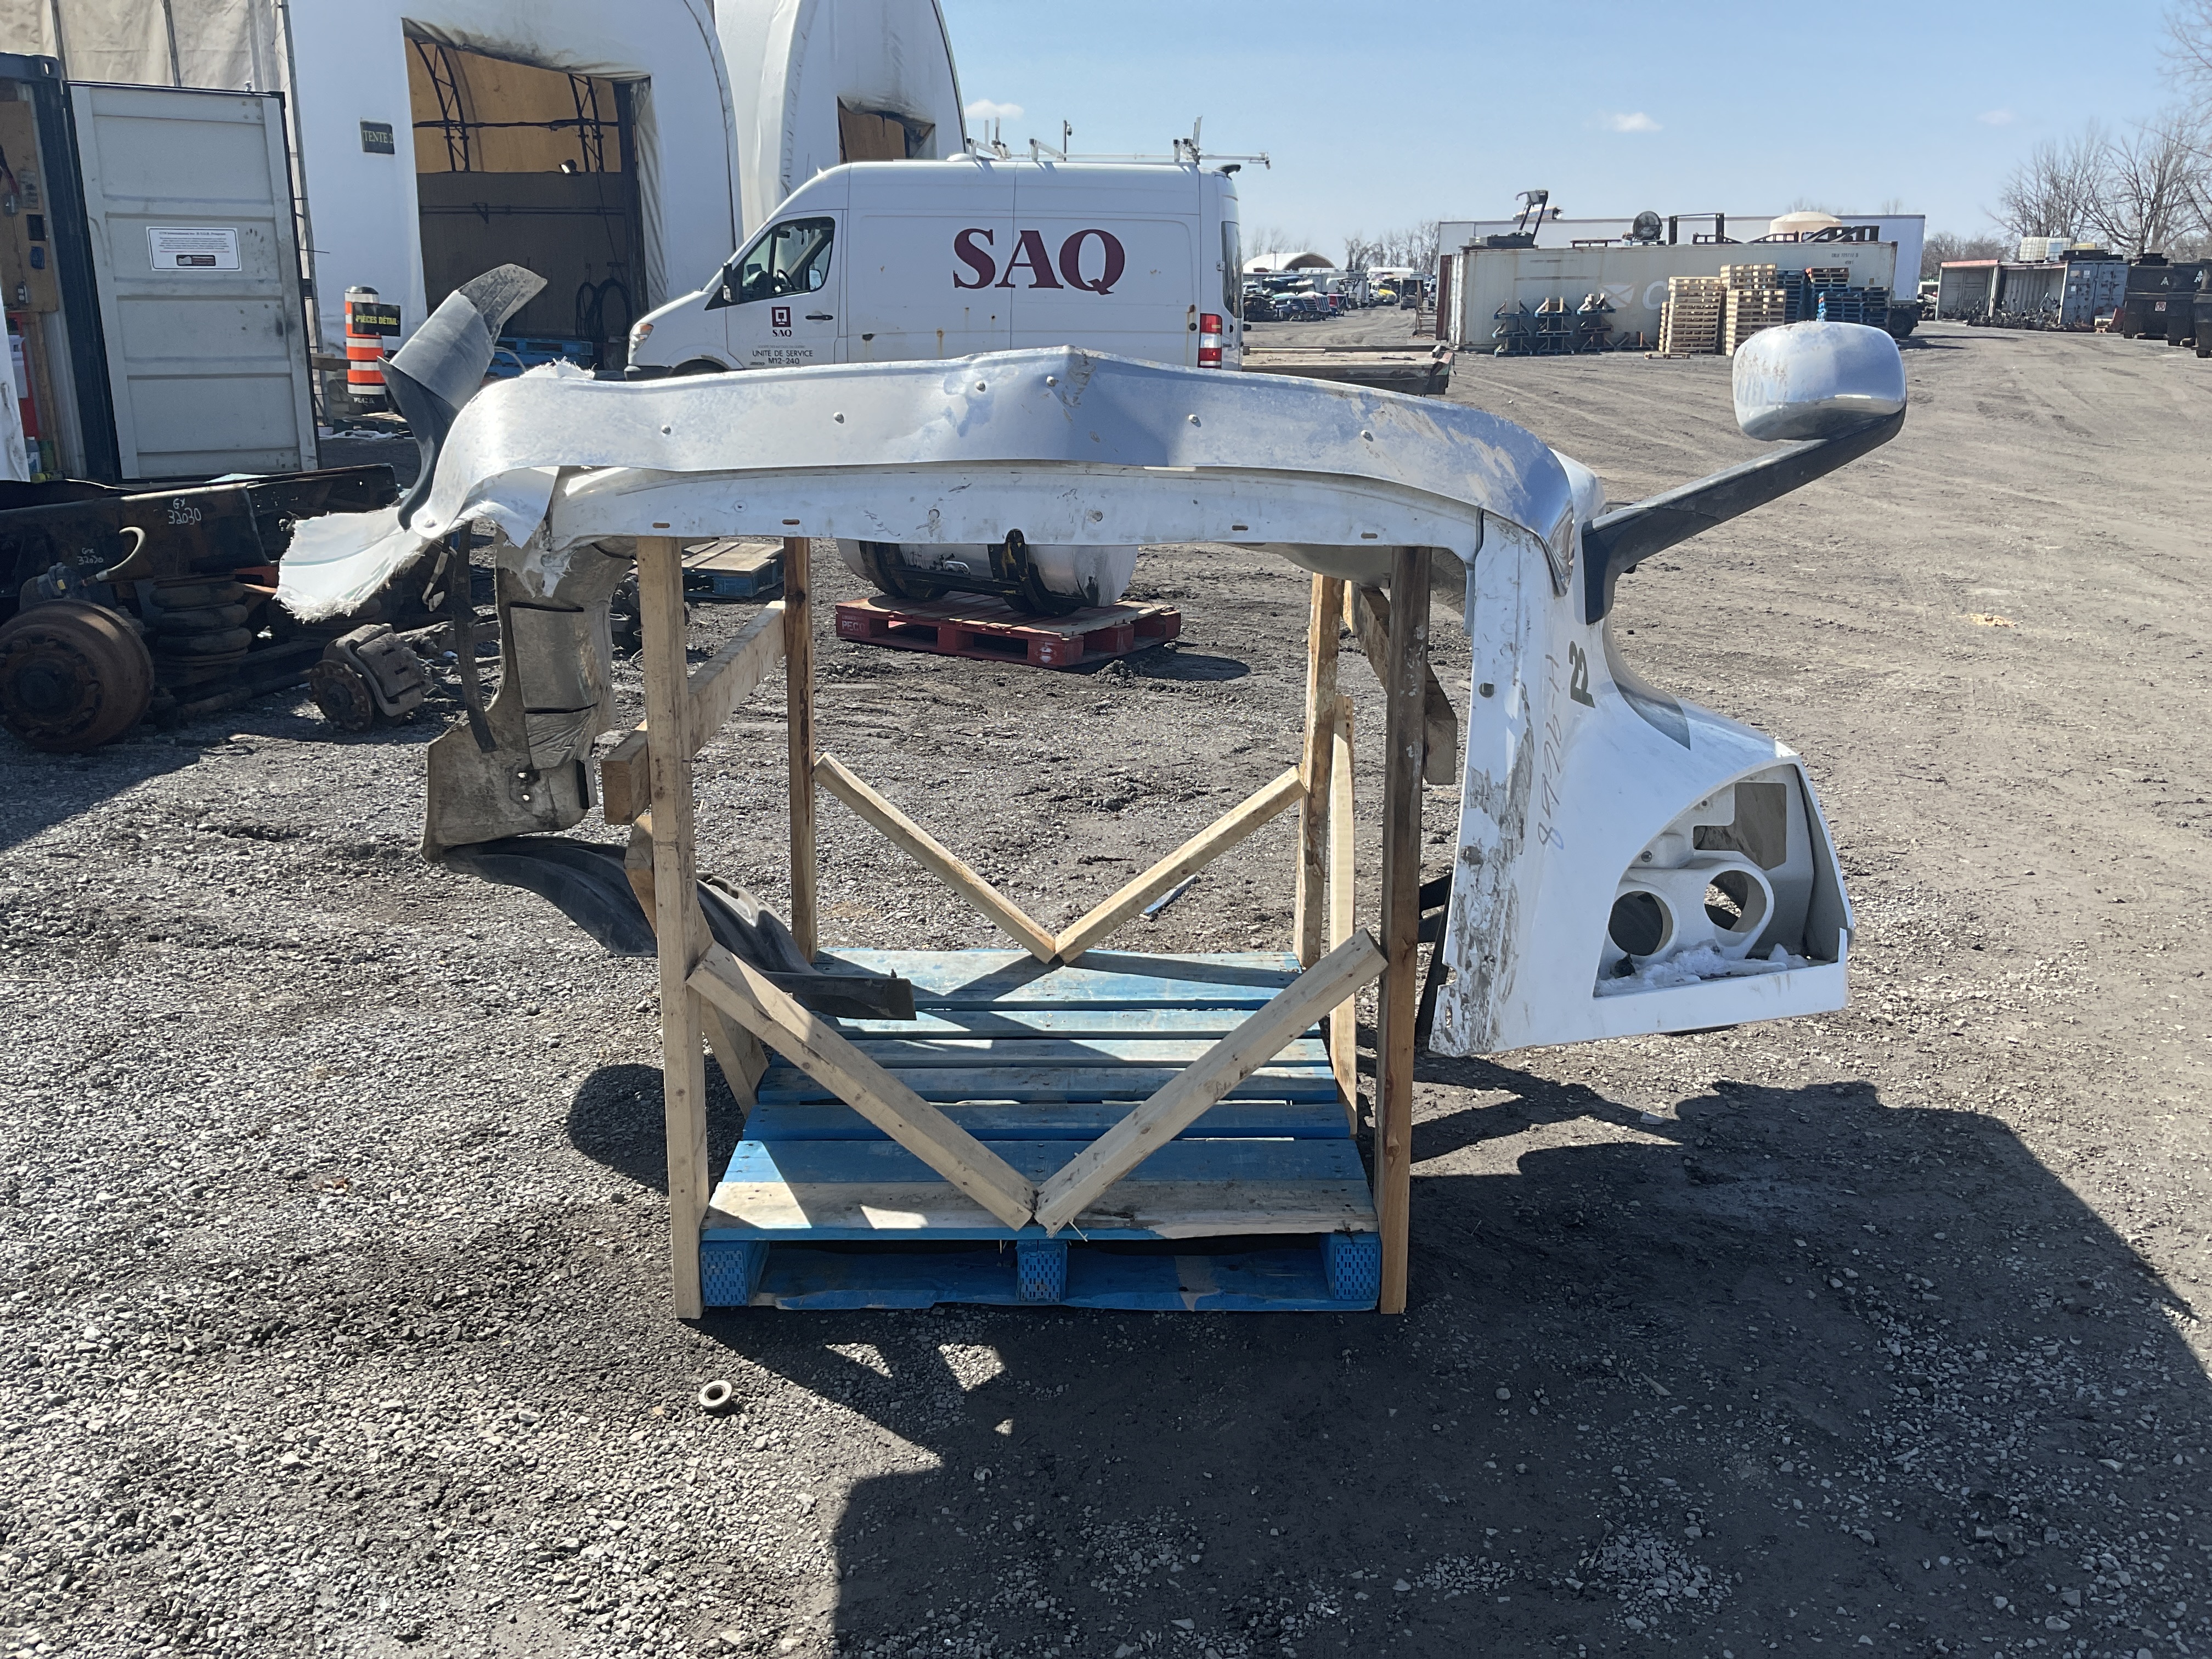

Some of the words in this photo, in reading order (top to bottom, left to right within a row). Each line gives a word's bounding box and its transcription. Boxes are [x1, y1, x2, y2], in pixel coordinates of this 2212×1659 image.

[363, 130, 388, 143] TENTE
[388, 133, 393, 143] 2
[953, 228, 1125, 296] SAQ
[356, 313, 377, 324] PIÈCES
[379, 315, 398, 325] DÉTAIL
[772, 329, 792, 337] SAQ
[167, 507, 201, 525] 32030
